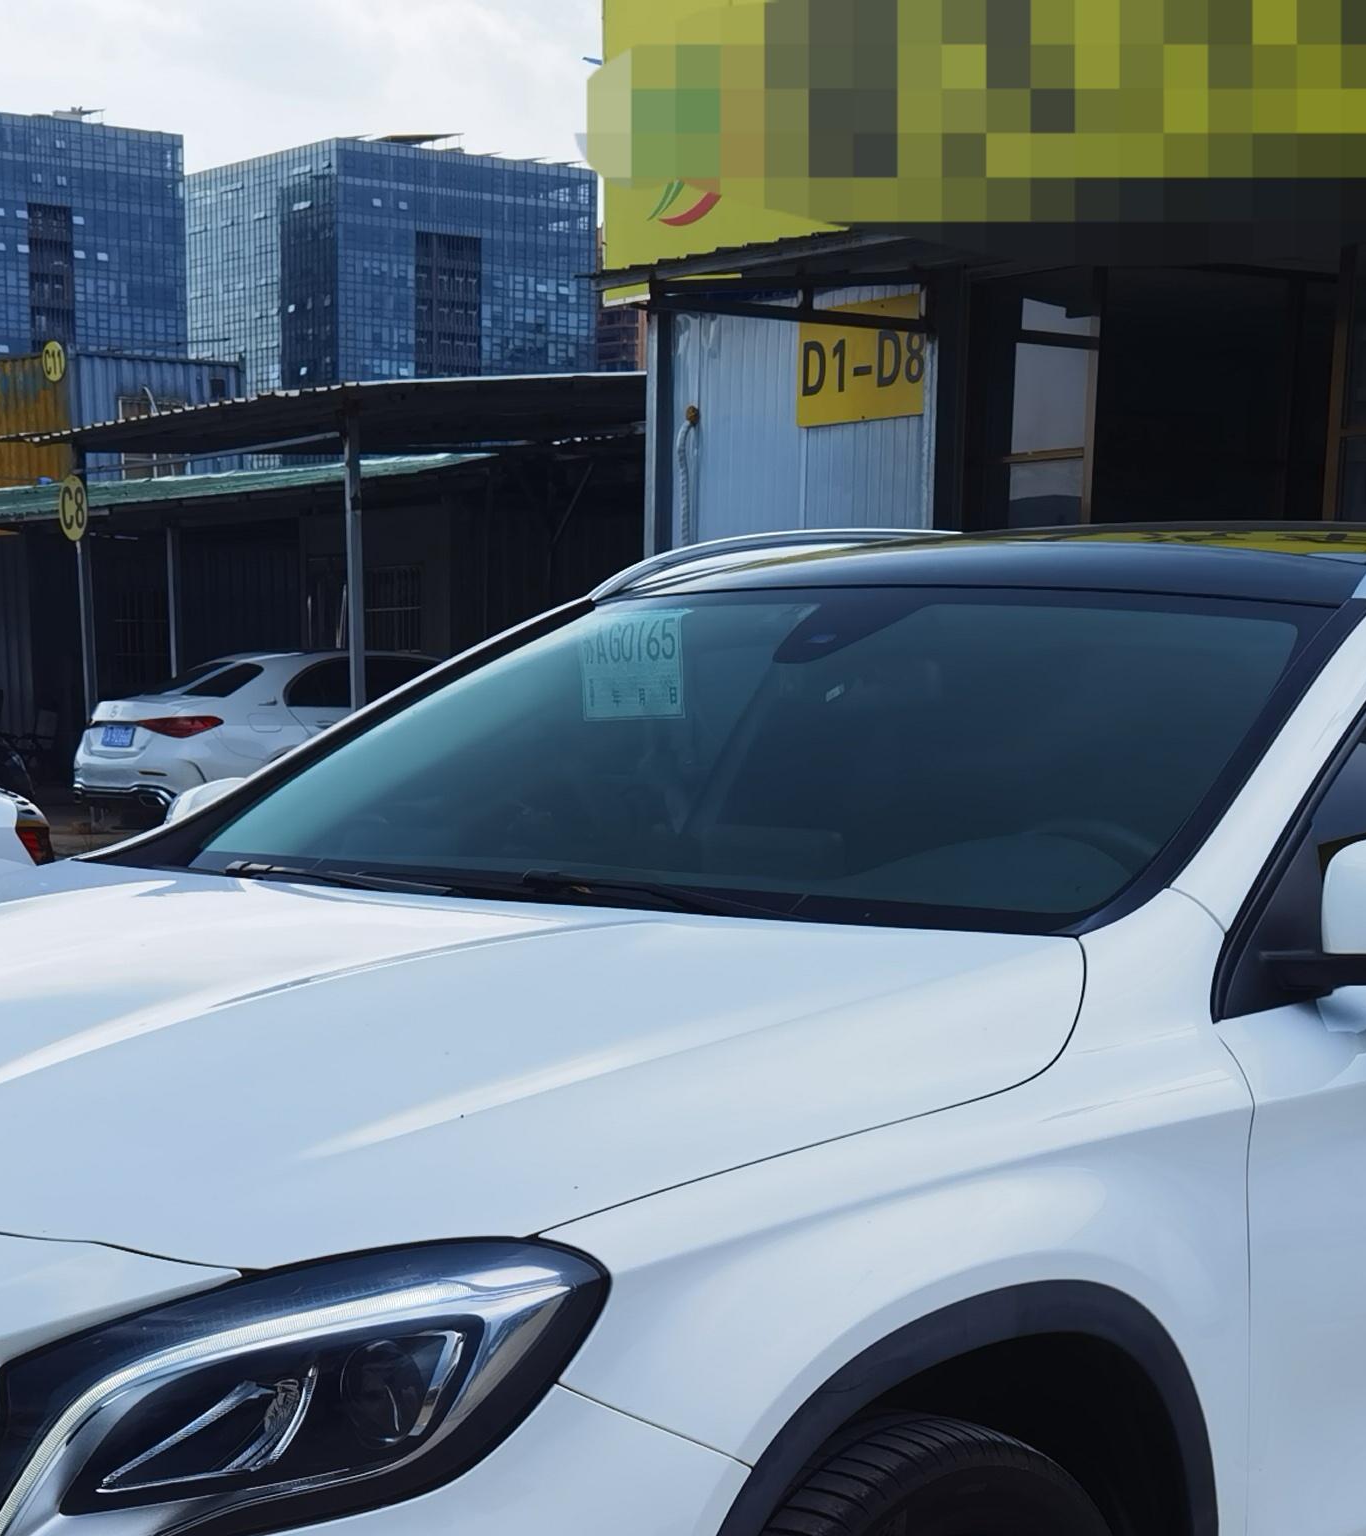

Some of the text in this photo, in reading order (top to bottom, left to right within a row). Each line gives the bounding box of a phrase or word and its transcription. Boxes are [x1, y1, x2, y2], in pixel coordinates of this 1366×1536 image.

[44, 349, 63, 375] C11
[802, 329, 924, 396] D1-D8
[61, 486, 84, 530] C8
